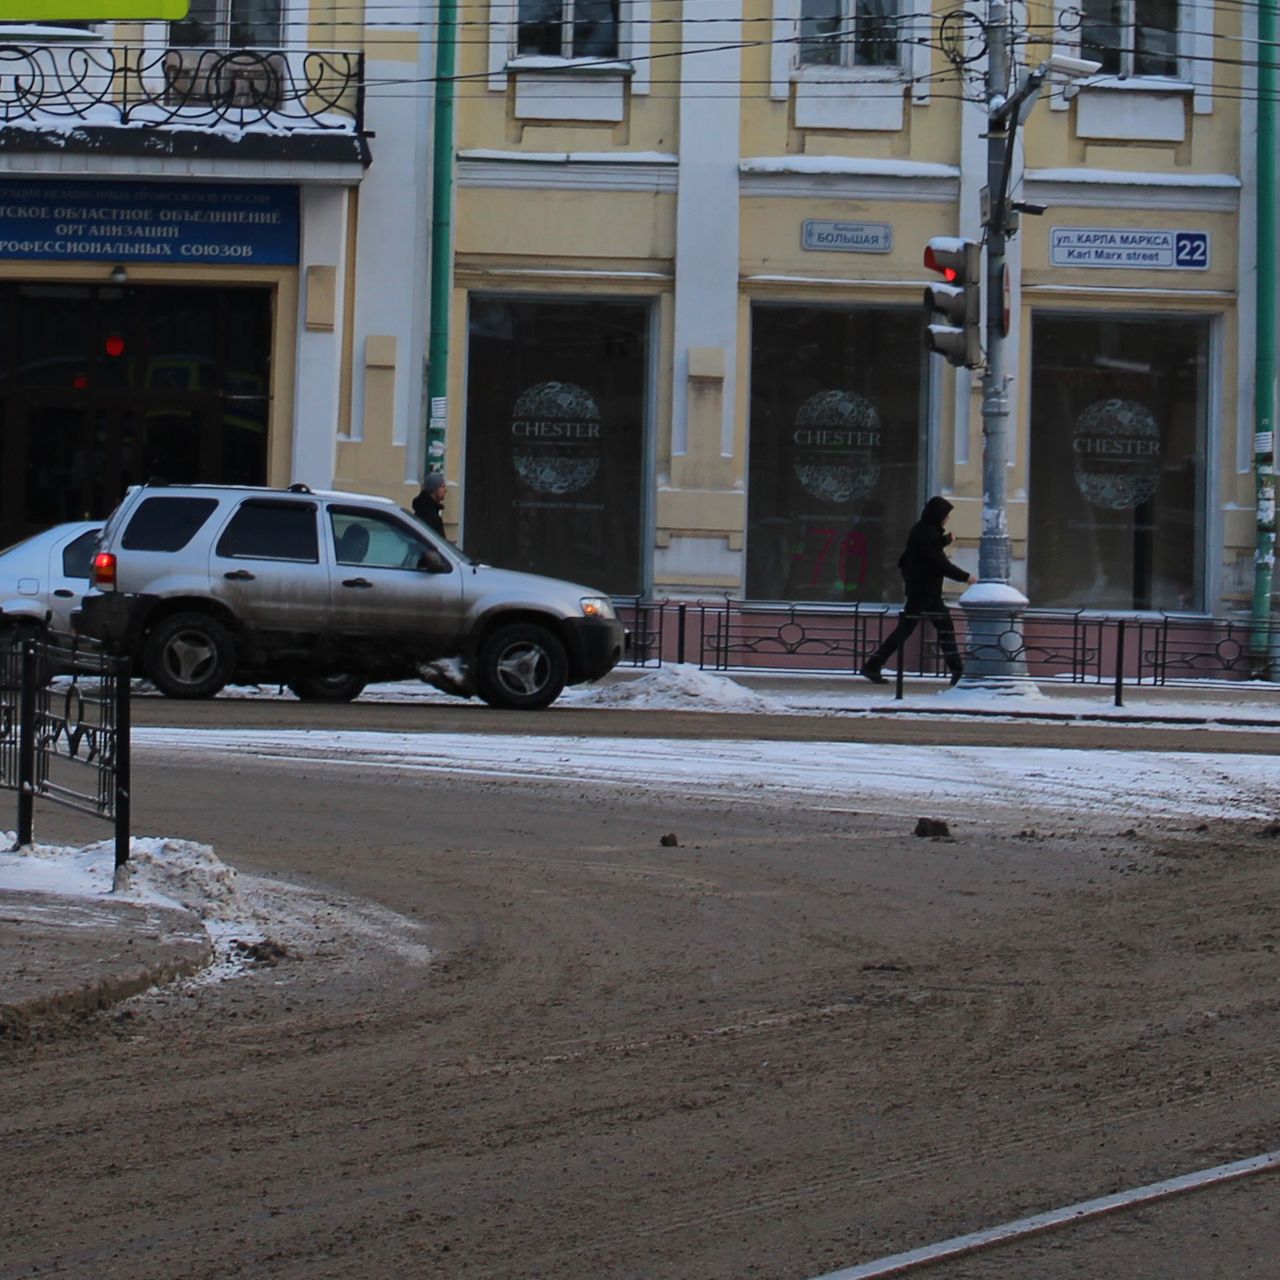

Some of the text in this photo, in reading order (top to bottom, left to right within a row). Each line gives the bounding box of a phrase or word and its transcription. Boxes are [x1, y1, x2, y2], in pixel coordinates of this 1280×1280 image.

[54, 207, 153, 222] ОБЛАСТНОЕ
[160, 208, 281, 224] ОБЪЕДИНЕНИЕ
[56, 223, 179, 238] ОРГАНИЗАЦИЙ
[817, 232, 879, 245] БОЛЬШАЯ
[1056, 233, 1170, 247] ул. КАРЛА МАРКСА
[181, 242, 253, 257] СОЮЗОВ
[1067, 248, 1160, 262] Karl Marx street
[1177, 239, 1206, 261] 22
[512, 421, 601, 438] CHESTER
[793, 430, 881, 446] CHESTER
[1073, 438, 1160, 455] CHESTER
